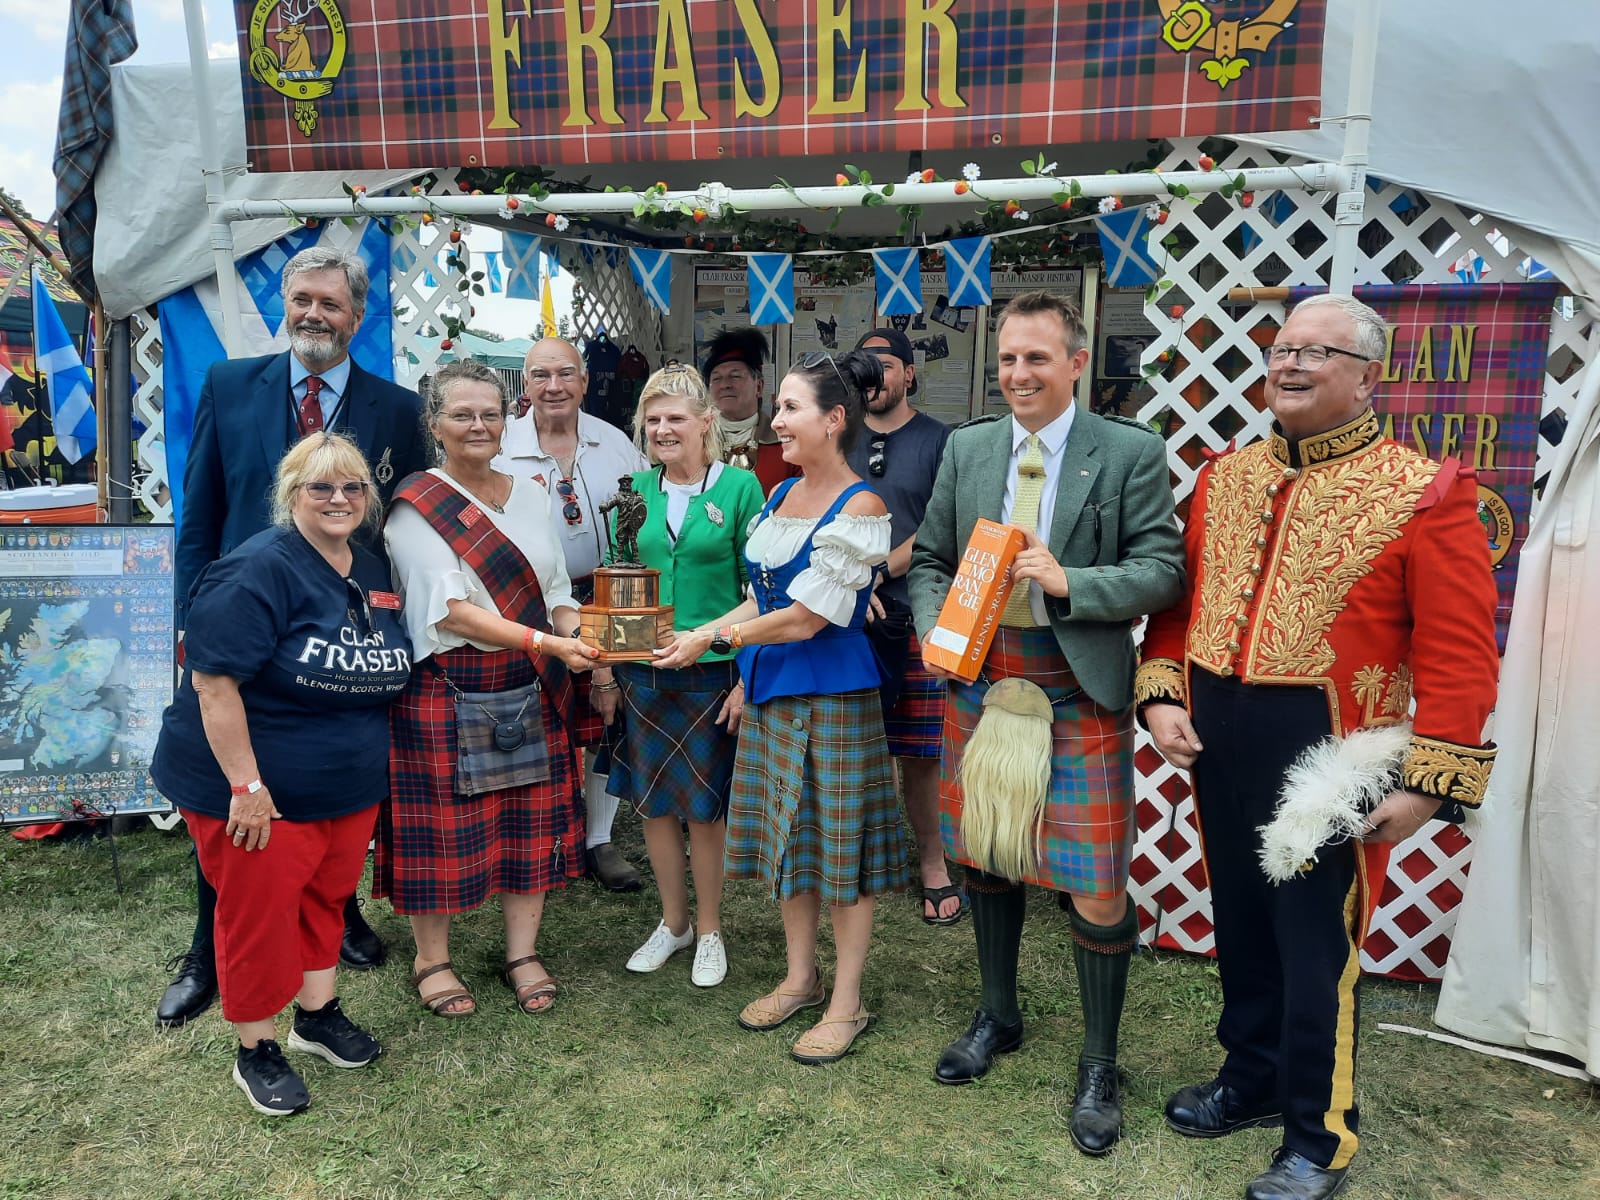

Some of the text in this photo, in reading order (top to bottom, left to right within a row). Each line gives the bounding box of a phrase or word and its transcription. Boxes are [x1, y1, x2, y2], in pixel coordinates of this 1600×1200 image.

[253, 15, 262, 29] JE
[322, 0, 342, 34] PREST
[488, 0, 967, 129] FRASER
[920, 274, 943, 284] RASER
[1380, 325, 1478, 382] LAN
[1488, 497, 1510, 536] IS IN GOD
[964, 547, 1000, 569] GLEN
[952, 572, 983, 594] RAN
[968, 564, 995, 583] MO
[958, 591, 982, 612] GIE
[340, 626, 385, 647] CLAN
[296, 636, 411, 673] FRASER
[296, 675, 347, 693] BLENDED
[349, 685, 383, 693] SCOTCH
[334, 673, 357, 682] HEART
